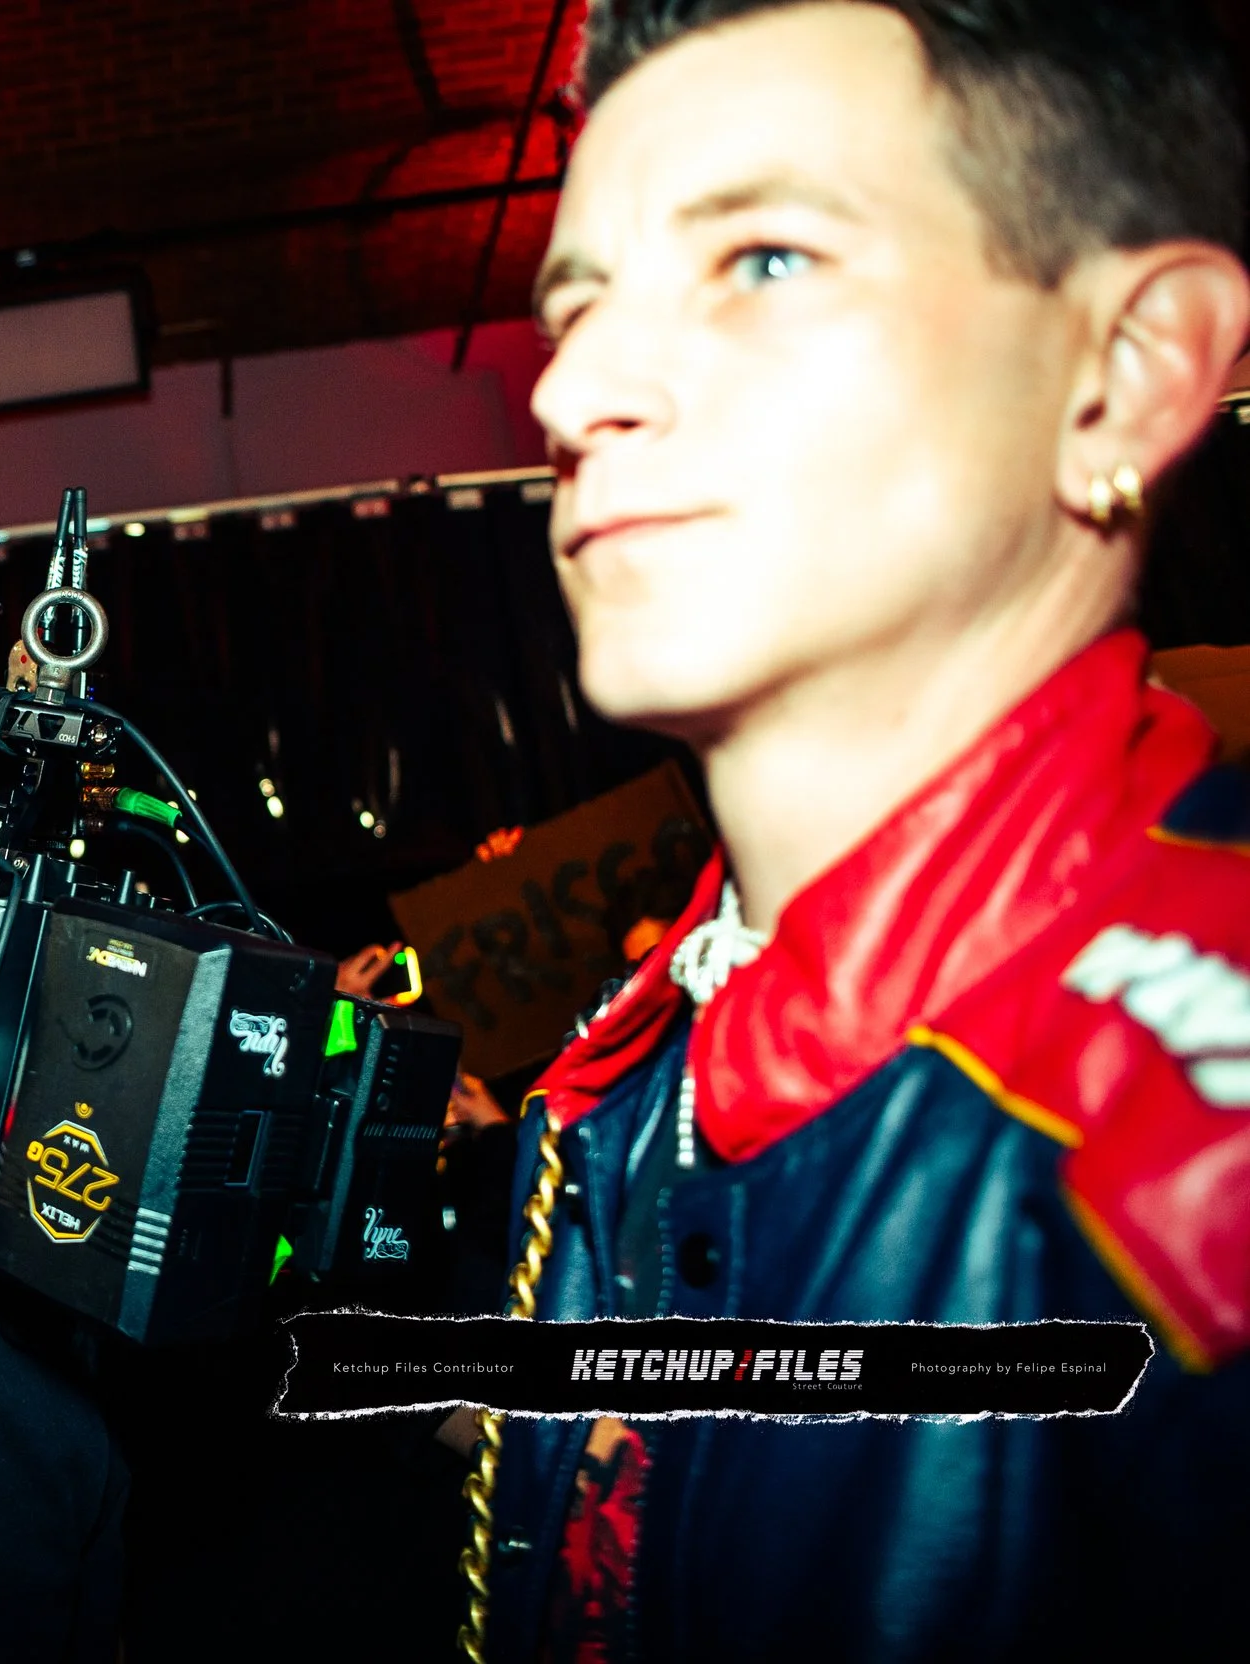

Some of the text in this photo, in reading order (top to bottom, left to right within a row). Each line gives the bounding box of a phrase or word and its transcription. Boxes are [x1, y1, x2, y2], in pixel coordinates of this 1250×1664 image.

[58, 733, 76, 744] CCH-5
[63, 1134, 90, 1153] MAX
[40, 1202, 82, 1231] HELIX
